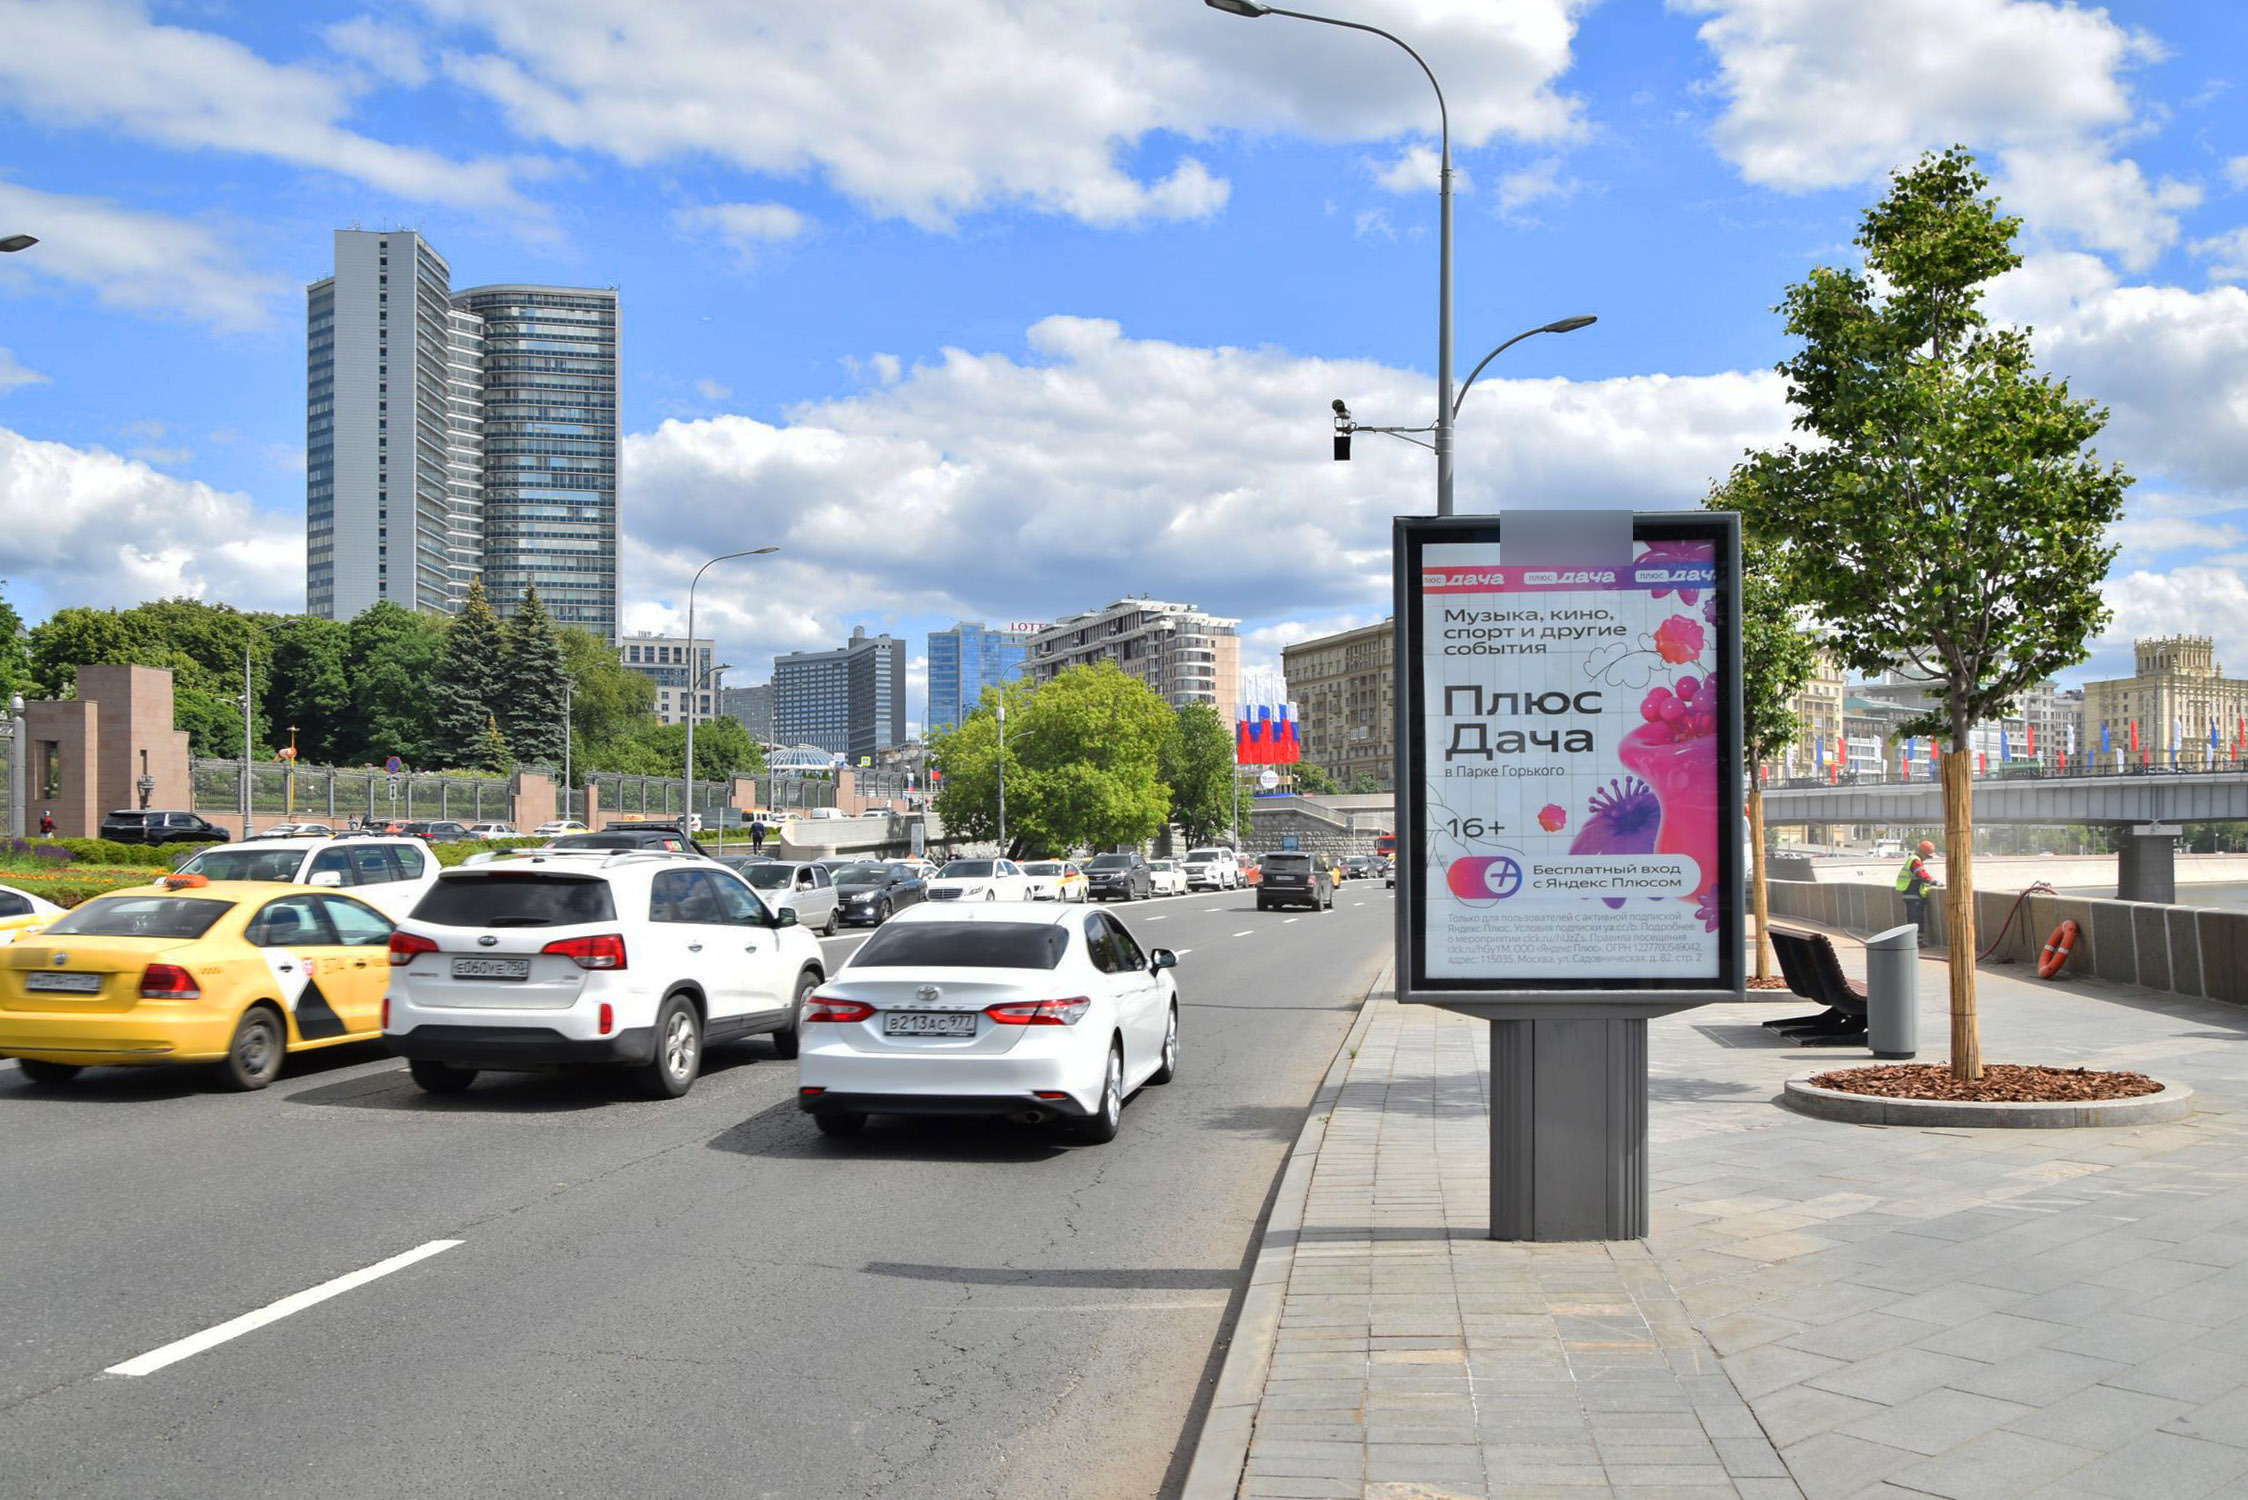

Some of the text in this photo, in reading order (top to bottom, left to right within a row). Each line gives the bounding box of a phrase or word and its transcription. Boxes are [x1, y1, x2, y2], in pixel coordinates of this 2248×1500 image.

[1446, 573, 1505, 586] дача
[1558, 571, 1616, 584] дача
[1669, 569, 1716, 581] дач
[1445, 609, 1614, 625] Музыка, кино,
[1444, 626, 1627, 641] спорт и другие
[1444, 641, 1547, 656] события
[1444, 685, 1602, 716] Плюс
[1445, 723, 1594, 761] Дача
[1445, 765, 1565, 779] в Парке Горького
[1447, 818, 1505, 837] 16+
[1533, 864, 1681, 876] Бесплатный вход
[1533, 878, 1682, 889] с Яндекс Плюсом
[1448, 914, 1480, 922] Только
[1482, 915, 1499, 923] для
[1501, 912, 1573, 922] пользователей
[1582, 912, 1627, 922] активной
[1629, 912, 1681, 922] подпиской
[1448, 924, 1481, 932] Яндекс
[1514, 924, 1553, 932] Условия
[1556, 924, 1602, 932] подписки
[1641, 922, 1695, 932] Подробнее
[1456, 936, 1521, 944] мероприятии
[1590, 934, 1632, 942] Правила
[1606, 944, 1632, 952] ОГРН
